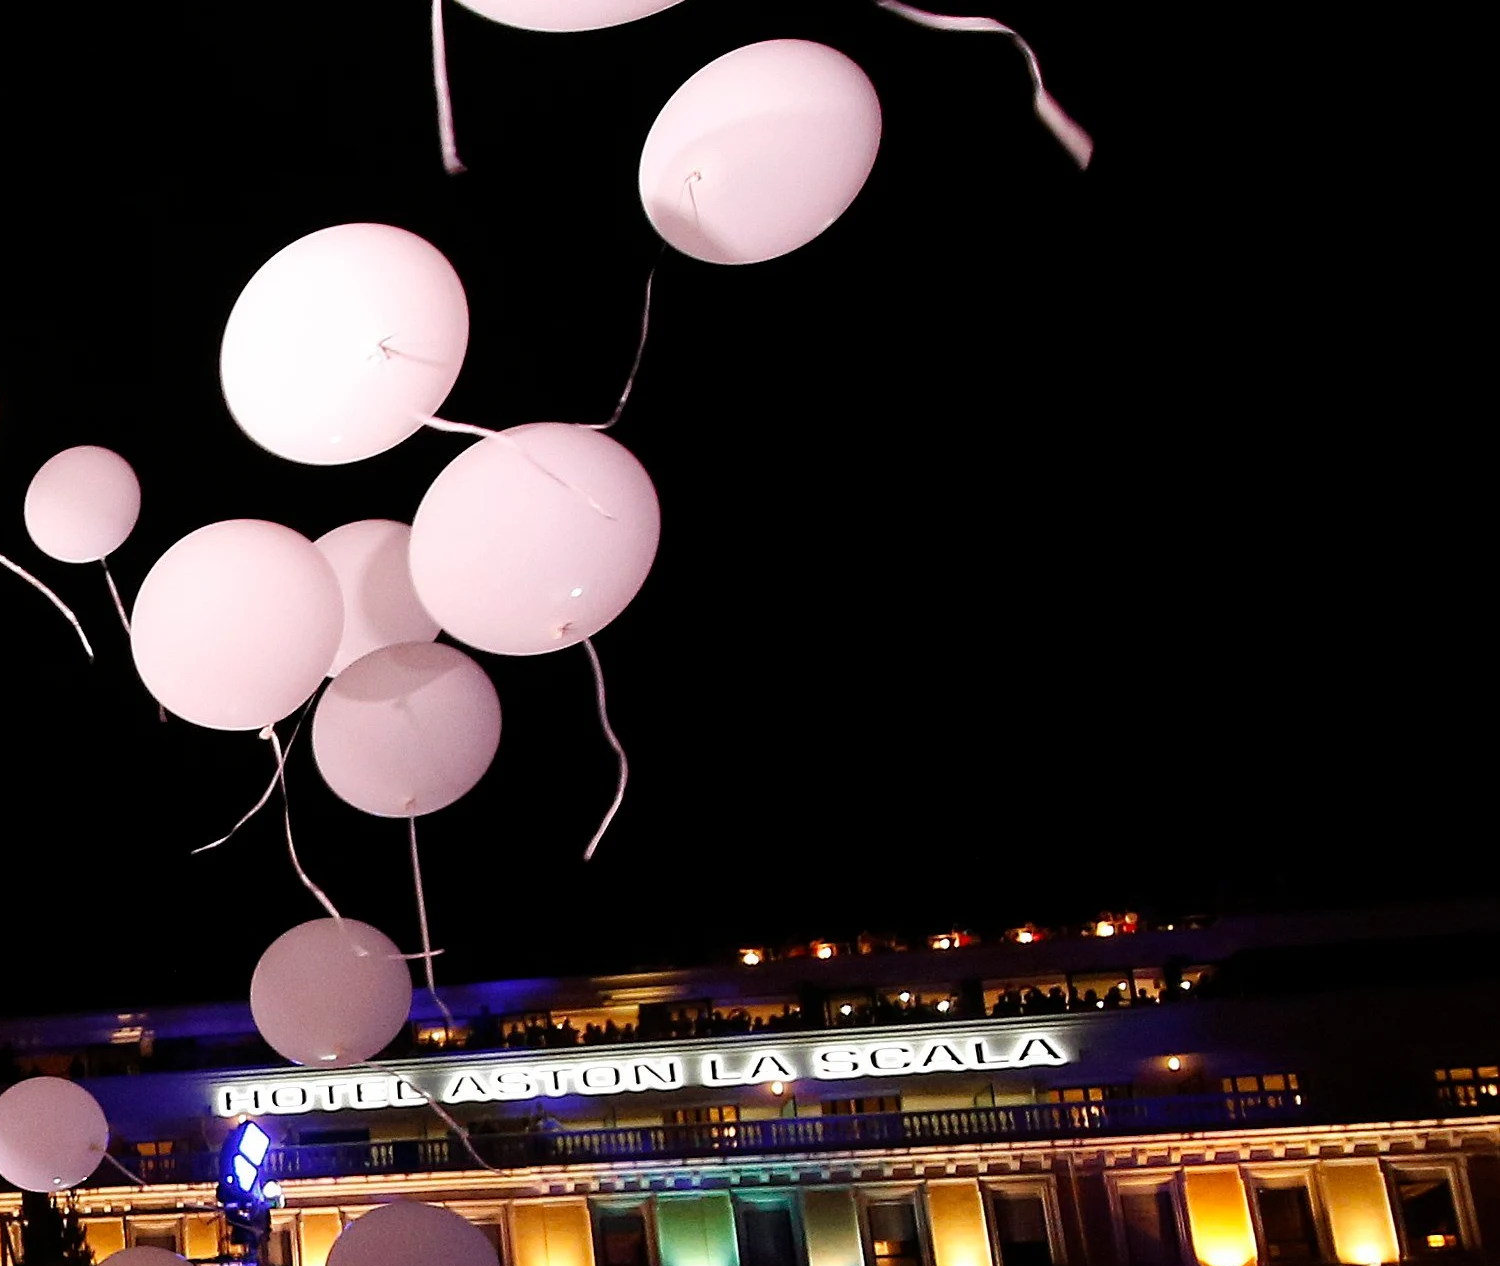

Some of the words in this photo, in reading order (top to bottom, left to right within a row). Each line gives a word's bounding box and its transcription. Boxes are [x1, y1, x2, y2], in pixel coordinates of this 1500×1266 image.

[222, 1077, 430, 1114] HOTEL
[446, 1059, 681, 1100] ASTON
[706, 1053, 794, 1084] LA
[816, 1035, 1065, 1077] SCALA
